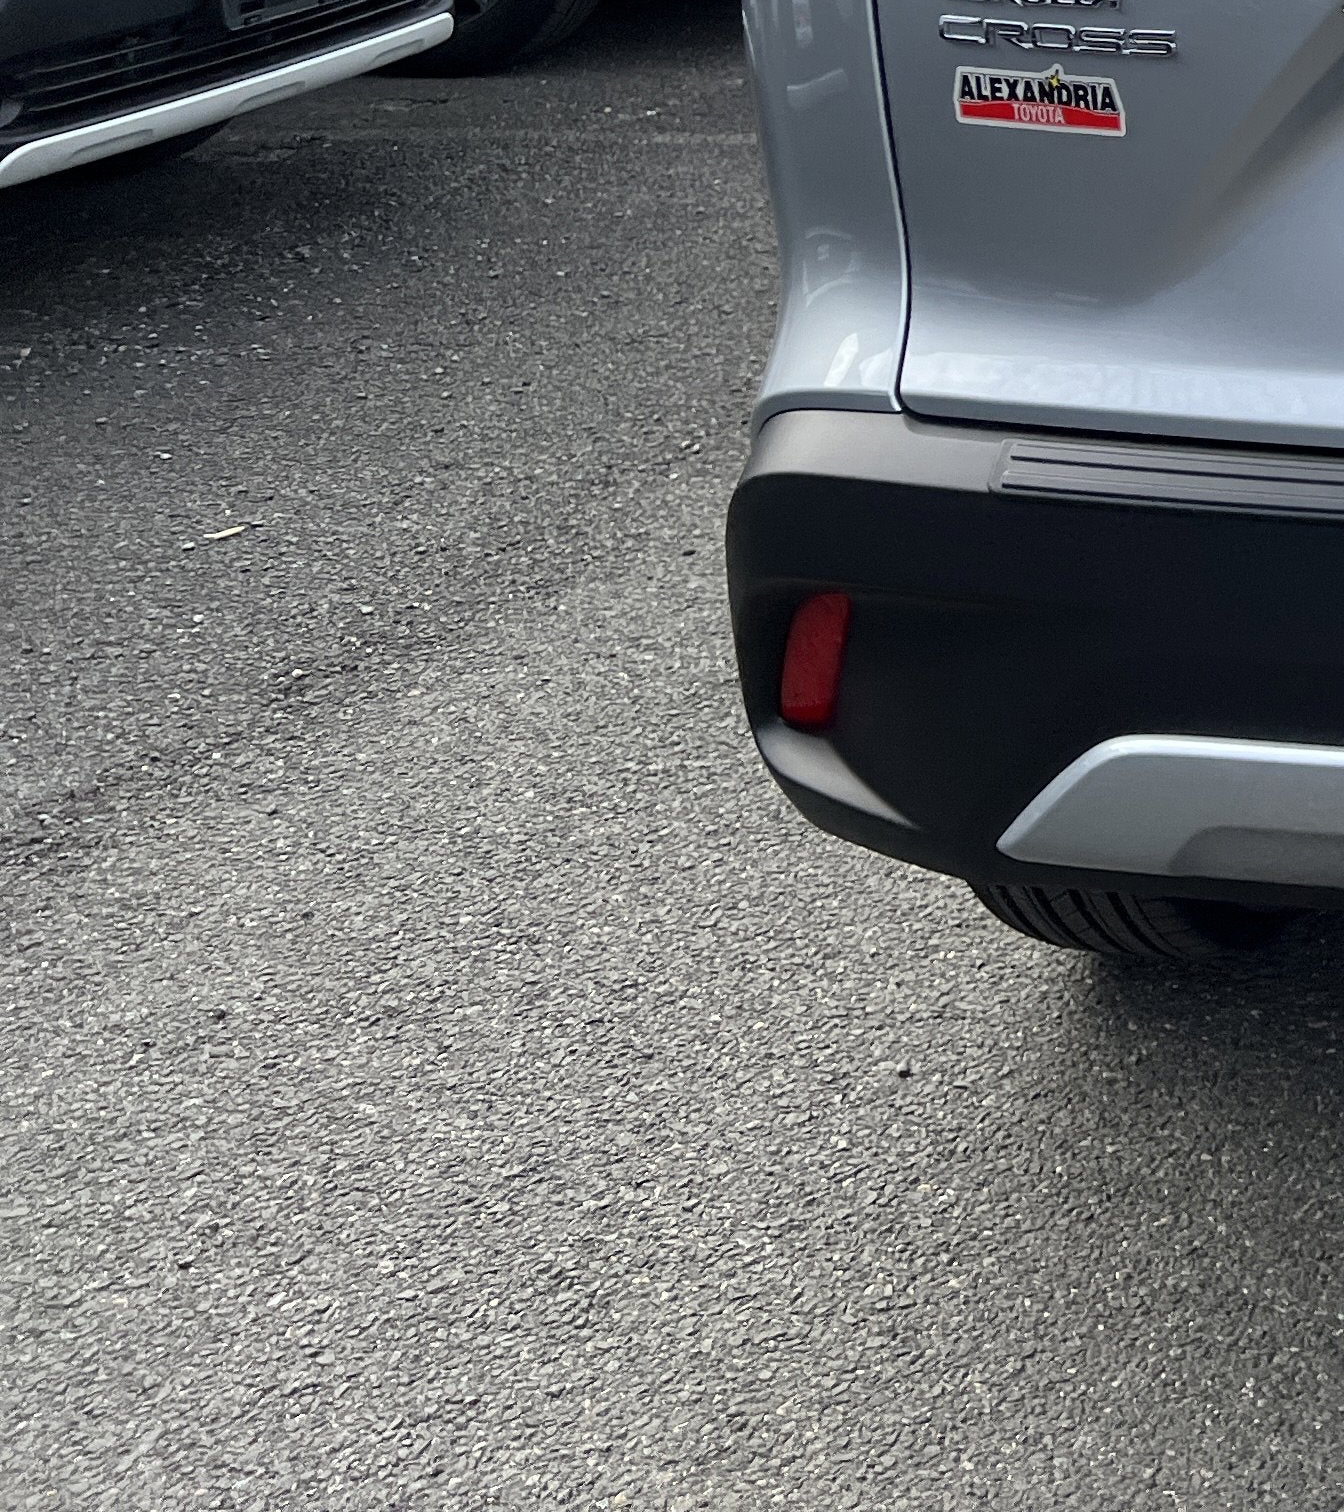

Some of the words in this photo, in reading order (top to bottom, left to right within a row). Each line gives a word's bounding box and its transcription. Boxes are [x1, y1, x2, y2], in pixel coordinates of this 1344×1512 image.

[938, 14, 1178, 57] CROSS
[960, 74, 1118, 112] ALEXANDRIA
[1013, 103, 1066, 124] TOYOTA
